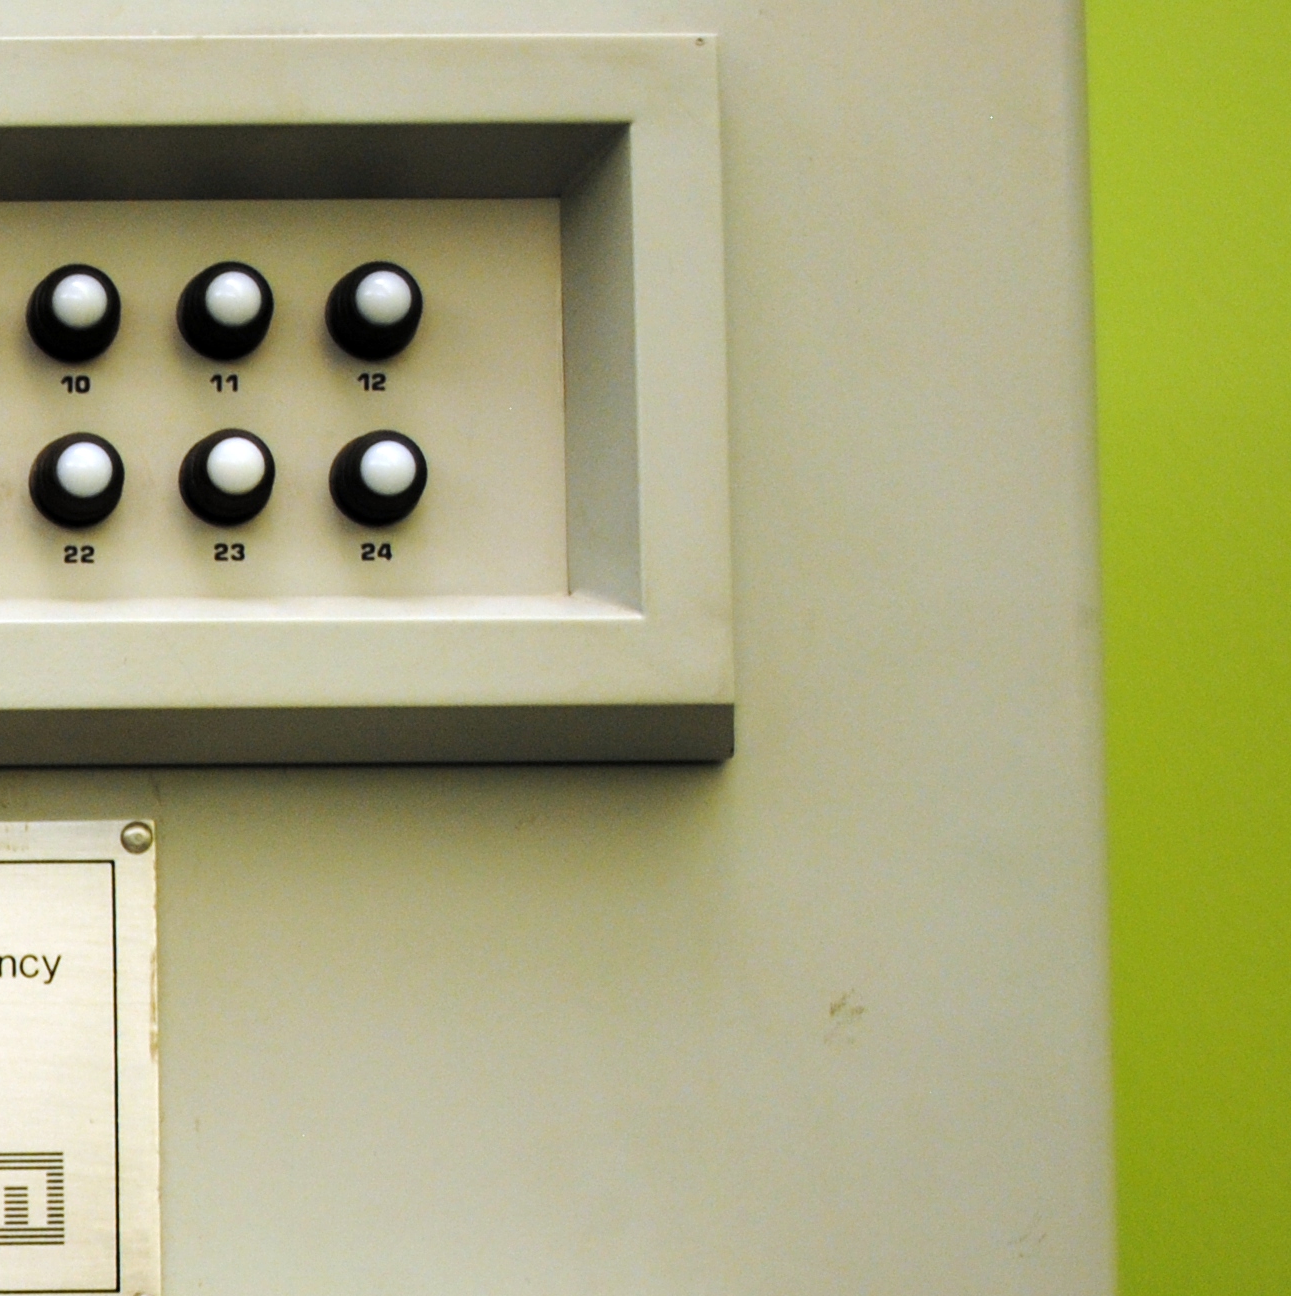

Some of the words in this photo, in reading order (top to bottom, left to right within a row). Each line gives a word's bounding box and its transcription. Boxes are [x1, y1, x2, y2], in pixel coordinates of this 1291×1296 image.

[61, 374, 90, 393] 10
[210, 373, 238, 392] 11
[357, 373, 386, 392] 12
[64, 544, 95, 563] 22
[214, 542, 245, 561] 23
[361, 542, 392, 561] 24
